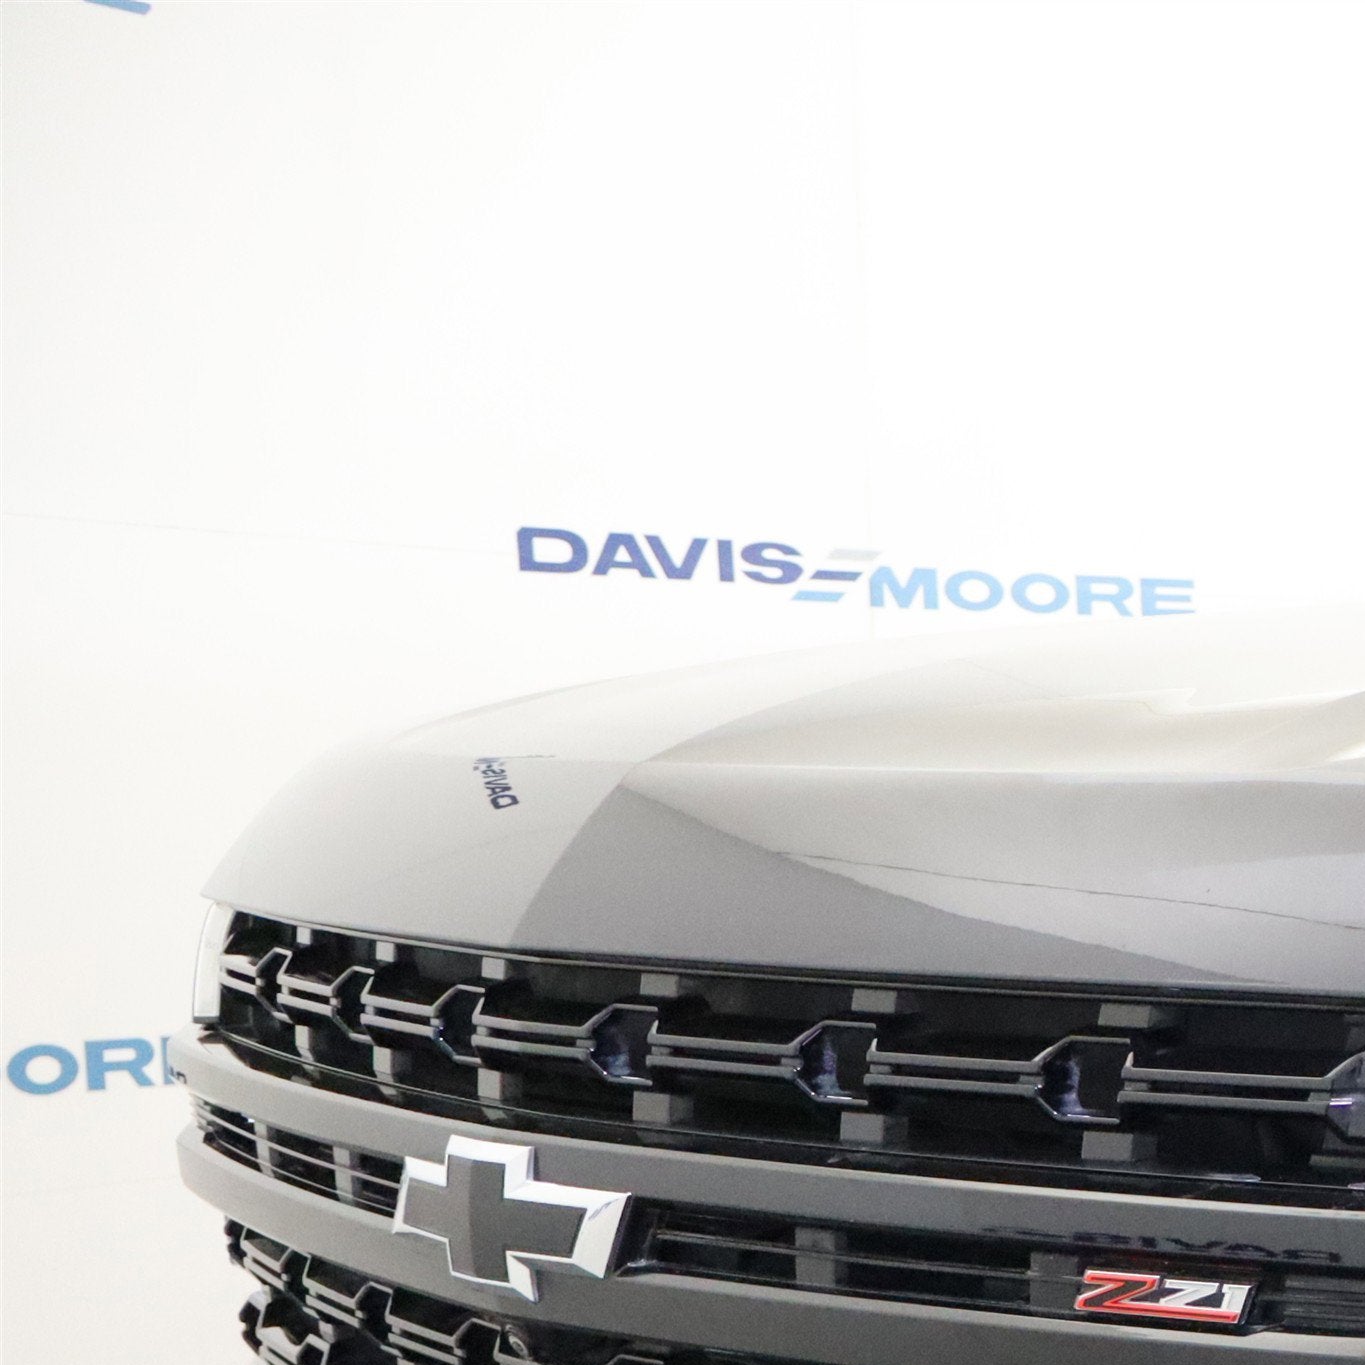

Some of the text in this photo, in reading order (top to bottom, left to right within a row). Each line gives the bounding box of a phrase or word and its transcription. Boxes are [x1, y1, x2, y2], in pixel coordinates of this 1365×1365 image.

[516, 524, 1196, 618] DAVIS MOORE
[1074, 1268, 1255, 1326] Z71
